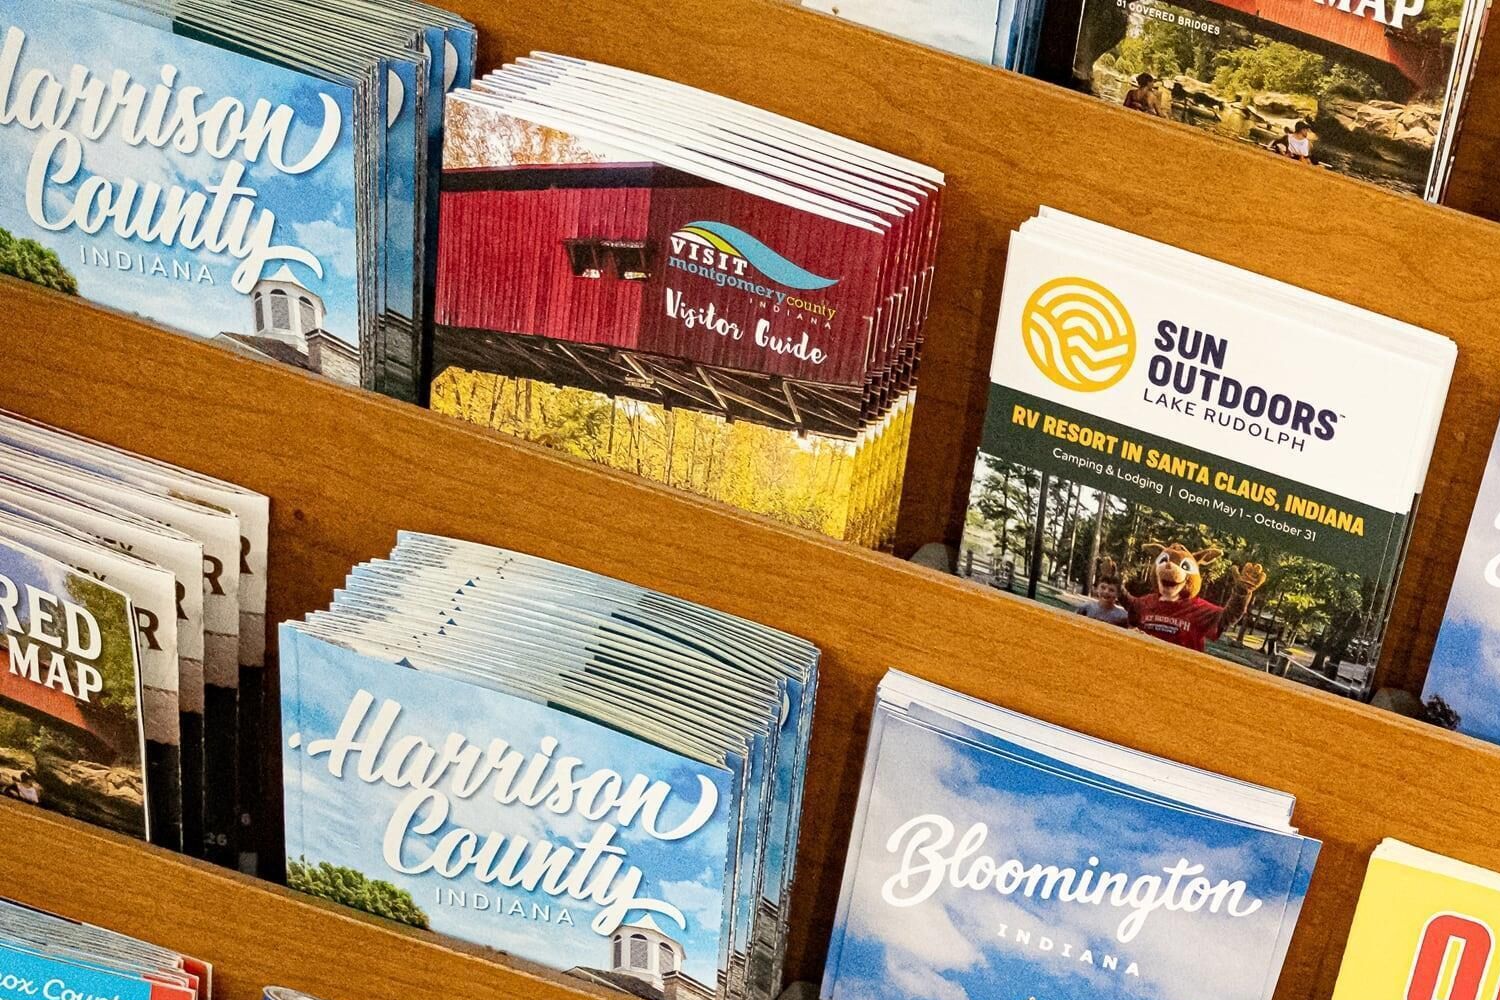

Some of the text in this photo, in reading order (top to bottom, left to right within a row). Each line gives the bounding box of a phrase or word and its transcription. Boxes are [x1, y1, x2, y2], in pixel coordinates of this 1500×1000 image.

[1129, 2, 1175, 23] COVERED
[1178, 16, 1220, 35] BRIDGES
[26, 129, 322, 294] County
[80, 245, 215, 284] INDIANA
[670, 236, 748, 275] VISIT
[666, 288, 827, 364] Visitor Guide
[750, 298, 831, 329] INDIANA
[1154, 320, 1228, 370] SUN
[1143, 388, 1306, 453] LAKE RUDOLPH
[1148, 354, 1338, 441] OUTDOORS
[1012, 405, 1364, 537] RV RESORT IN SANTA CLAUS, INDIANA
[1052, 447, 1102, 476] Camping
[1106, 463, 1114, 476] &
[1117, 467, 1163, 494] Lodging
[1178, 488, 1209, 511] Open
[1212, 497, 1238, 520] May
[1254, 513, 1302, 541] October
[1303, 526, 1317, 543] 31
[7, 634, 103, 703] MAP
[288, 689, 718, 841] Harrison
[382, 790, 686, 936] County
[881, 814, 1262, 943] Bloomington
[436, 887, 574, 927] INDIANA
[998, 923, 1141, 978] INDIANA
